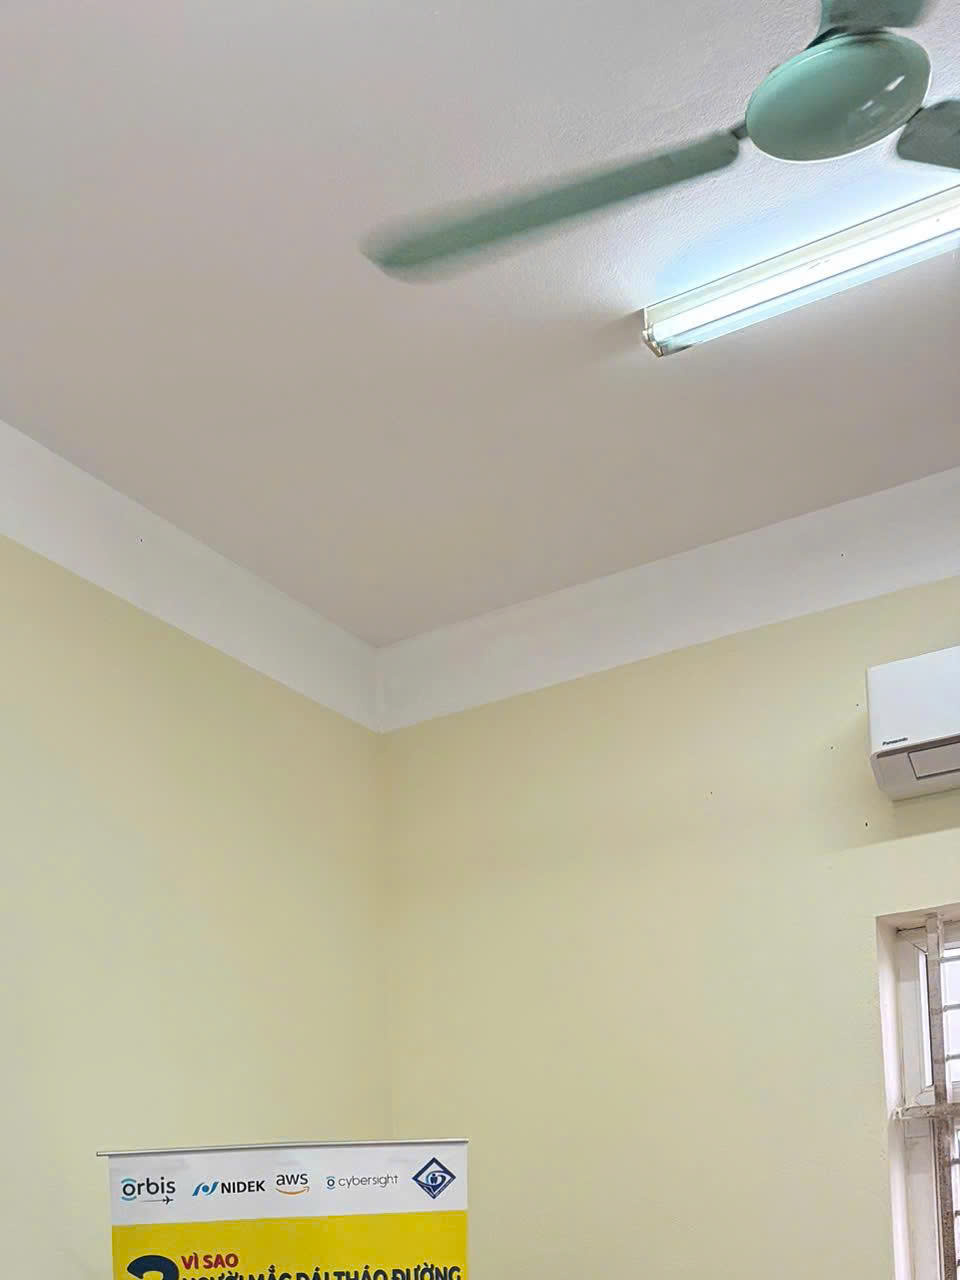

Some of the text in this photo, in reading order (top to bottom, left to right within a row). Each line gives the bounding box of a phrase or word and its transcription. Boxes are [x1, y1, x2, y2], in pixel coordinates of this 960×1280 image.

[122, 1176, 176, 1197] orbis
[221, 1180, 266, 1194] NIDEK
[276, 1173, 308, 1186] aws
[338, 1174, 399, 1189] cybersight
[181, 1252, 239, 1270] VÌ SAO
